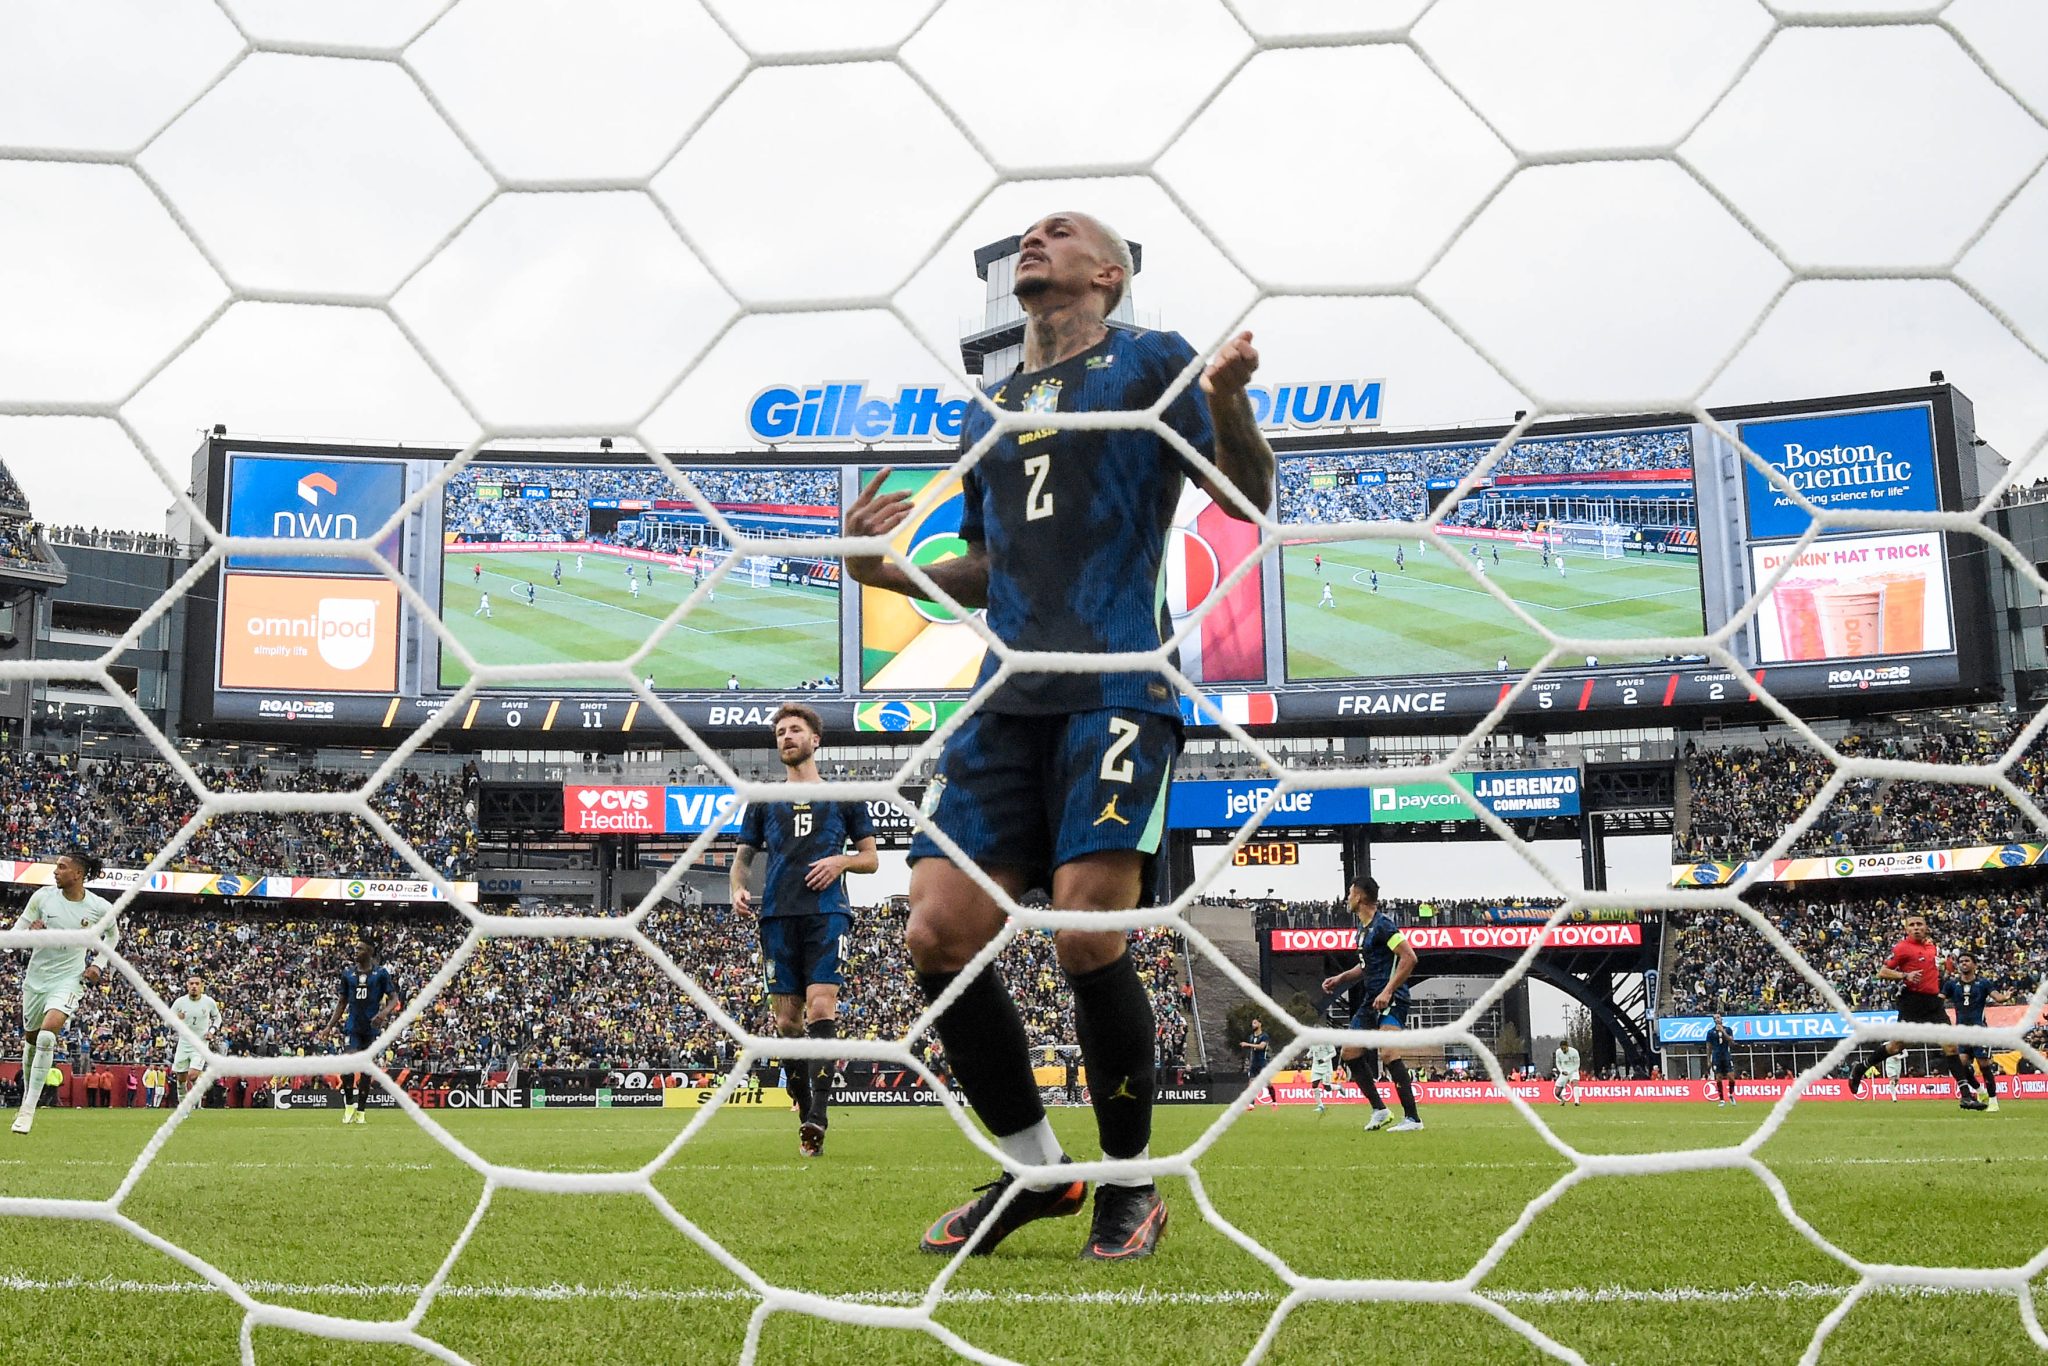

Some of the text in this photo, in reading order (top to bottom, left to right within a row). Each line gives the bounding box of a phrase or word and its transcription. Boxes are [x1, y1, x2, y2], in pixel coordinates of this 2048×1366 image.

[750, 383, 1382, 438] Gillette DIUM
[1018, 427, 1059, 446] BRASIL
[1783, 443, 1877, 469] Boston
[1361, 475, 1381, 483] FRA
[1768, 451, 1912, 492] Scientific
[526, 489, 545, 497] FRA
[1024, 453, 1054, 522] 2
[1773, 493, 1828, 507] Advcing
[1830, 490, 1868, 501] science
[1870, 488, 1885, 498] for
[273, 511, 358, 540] nwn
[1834, 549, 1870, 564] HAT
[1874, 543, 1931, 561] TRICK
[246, 614, 372, 641] omnipod
[253, 645, 308, 657] simplify life
[1616, 679, 1645, 687] SAVES
[1694, 673, 1737, 683] CORNERS
[1532, 683, 1561, 691] SHOTS
[1709, 683, 1725, 700] 2
[415, 700, 450, 708] CORNE
[1337, 692, 1447, 715] FRANCE
[1538, 693, 1553, 709] 5
[1622, 688, 1638, 705] 2
[506, 710, 522, 727] 0
[582, 711, 603, 728] 11
[708, 706, 780, 725] BRAZ
[1100, 716, 1140, 784] 2
[600, 790, 649, 810] CVS
[1225, 787, 1313, 820] jetBlue
[1493, 797, 1560, 812] COMPANIES
[866, 800, 917, 818] ROS
[793, 813, 813, 838] 15
[873, 818, 917, 828] RANCE
[1234, 843, 1296, 866] 64:03
[1906, 855, 1923, 865] 26
[98, 872, 123, 881] OAD
[413, 884, 428, 893] 26
[1403, 928, 1453, 948] YOTA
[1460, 926, 1542, 946] TOYOTA
[1551, 926, 1634, 945] TOYOTA
[355, 987, 368, 1000] 20
[192, 1016, 197, 1026] 2
[1756, 1019, 1838, 1037] ULTRA
[535, 1092, 596, 1104] enterprise
[600, 1092, 663, 1104] enterprise
[697, 1087, 765, 1105] sirit
[835, 1091, 910, 1103] UNIVERSAL
[1156, 1089, 1207, 1100] AIRLINES
[1279, 1087, 1391, 1099] TURKSH AIRLES
[1427, 1087, 1540, 1098] TURKISH AIRINES
[1578, 1086, 1690, 1097] TURKISH AIRLINES
[1784, 1084, 1841, 1096] ALINES
[291, 1095, 328, 1103] CELSIUS
[366, 1095, 396, 1103] ELSIUS
[408, 1089, 523, 1108] BETONLINE
